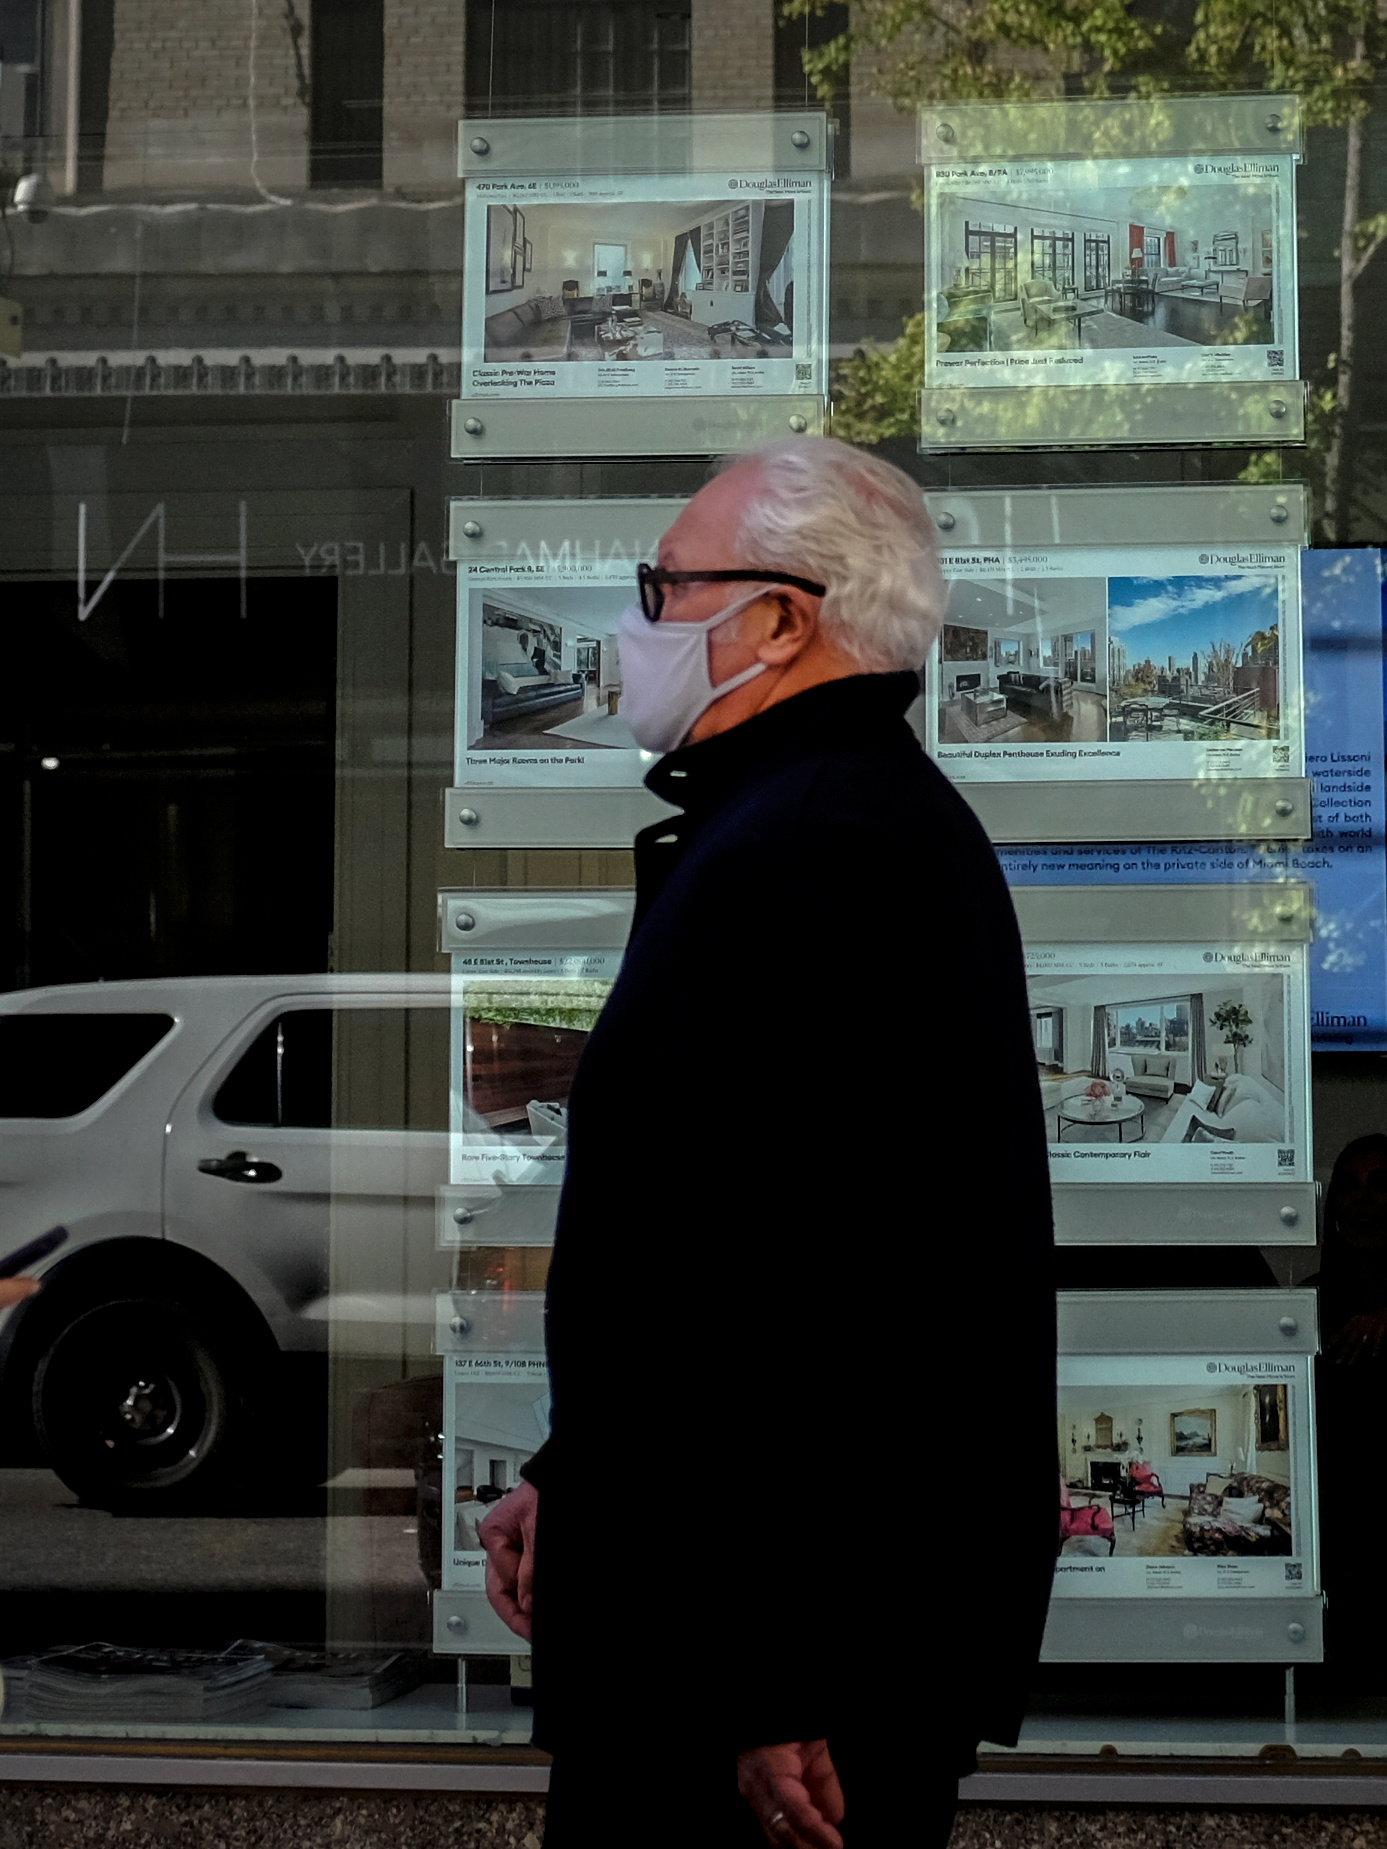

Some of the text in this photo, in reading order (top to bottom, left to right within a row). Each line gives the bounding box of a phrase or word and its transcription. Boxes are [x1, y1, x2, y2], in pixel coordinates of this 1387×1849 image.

[472, 369, 499, 377] Classic
[472, 379, 518, 388] Overlooking
[983, 556, 1001, 564] PHA
[479, 565, 508, 573] Central
[937, 749, 1121, 760] Beautiful Duplex Penthouse Exuding Excellence
[1305, 752, 1371, 763] iero Lissoni
[466, 757, 488, 765] Three
[489, 757, 510, 766] Major
[511, 757, 538, 765] Rooms
[1312, 767, 1372, 777] waterside
[1320, 782, 1372, 793] landside
[1328, 812, 1372, 823] of both
[1338, 827, 1372, 838] world
[1050, 847, 1074, 856] and
[1076, 847, 1127, 856] services
[1129, 846, 1142, 855] of
[1338, 845, 1352, 854] on
[1356, 845, 1372, 854] an
[1041, 863, 1065, 871] new
[1068, 862, 1120, 873] meaning
[1122, 862, 1138, 870] on
[1141, 861, 1161, 870] the
[1163, 861, 1206, 873] private
[1210, 858, 1234, 870] side
[1237, 858, 1250, 870] of
[1252, 858, 1289, 869] Miami
[1292, 858, 1333, 869] Beach.
[1026, 952, 1056, 960] 725,000
[461, 1153, 480, 1161] Rare
[1047, 1150, 1072, 1159] lassic
[1133, 1150, 1151, 1159] Flair
[492, 1360, 504, 1368] St,
[453, 1558, 480, 1568] Unique
[1055, 1565, 1094, 1574] partment
